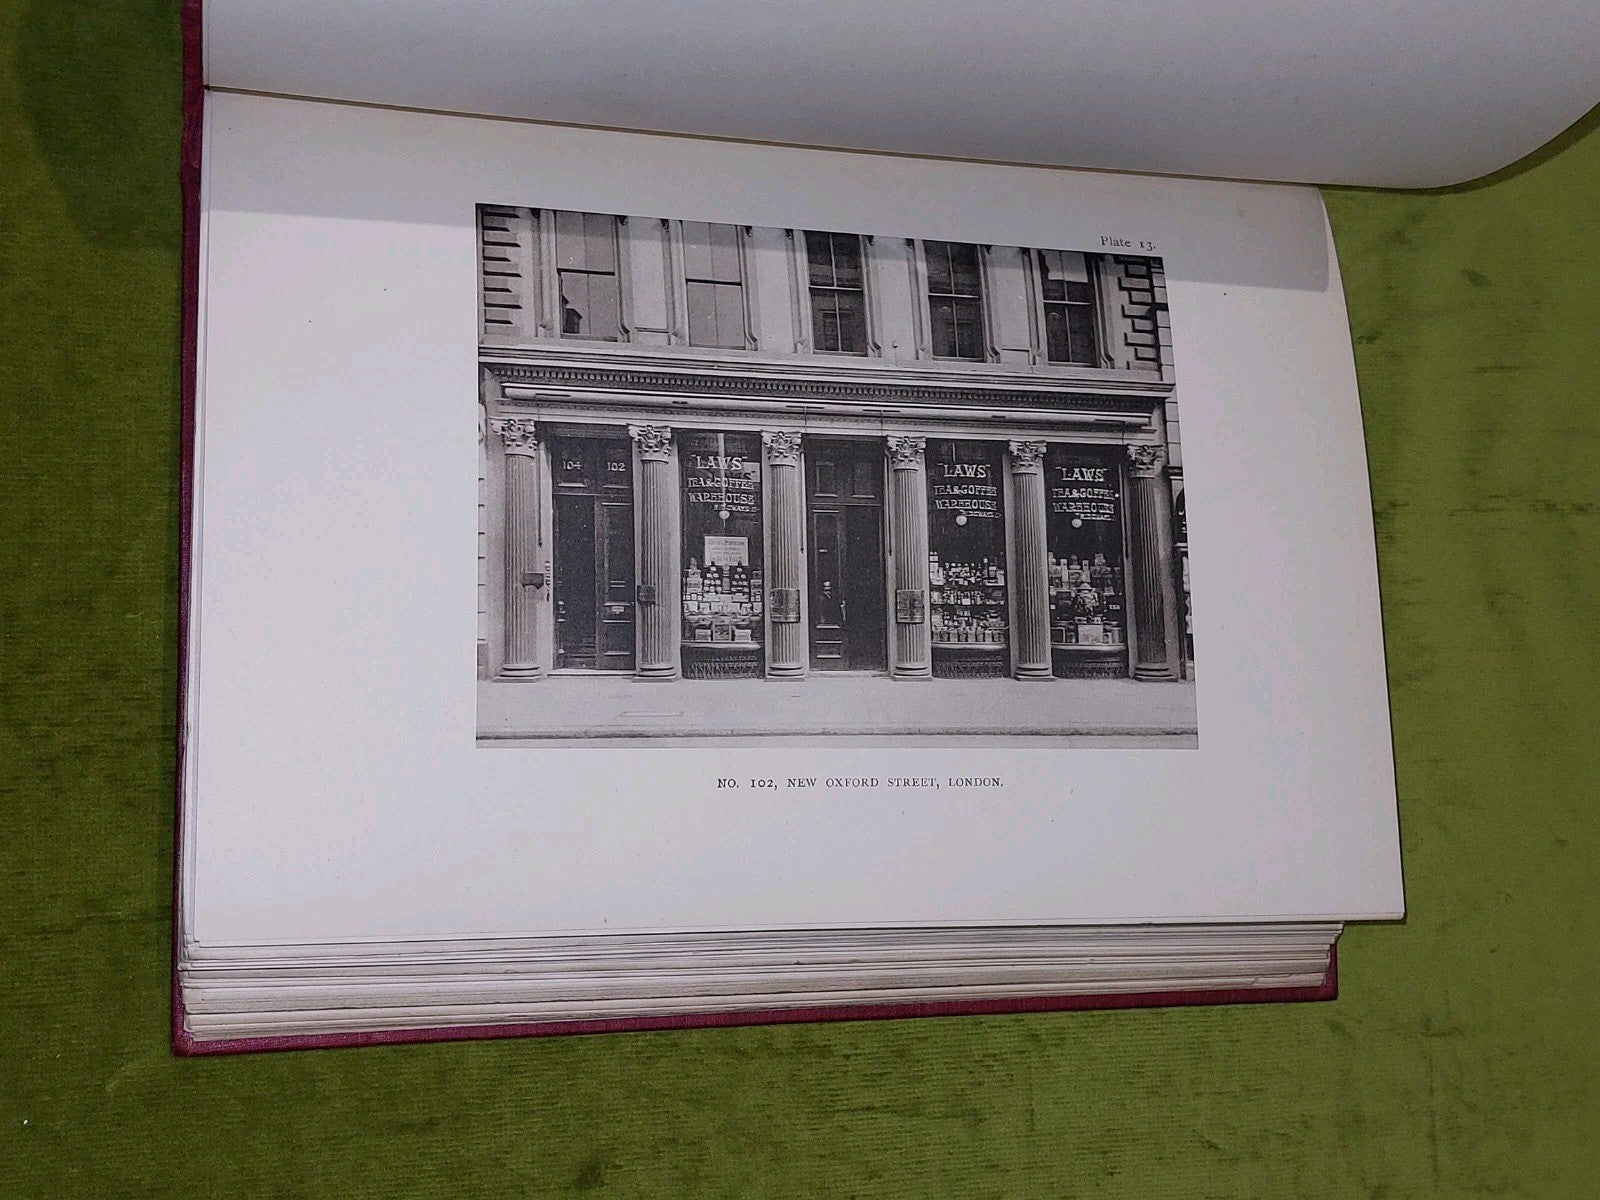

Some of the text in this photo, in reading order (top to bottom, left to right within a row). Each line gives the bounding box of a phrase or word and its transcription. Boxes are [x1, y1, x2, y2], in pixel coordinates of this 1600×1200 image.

[1100, 235, 1156, 252] Plate 13.
[562, 460, 582, 470] 104
[606, 461, 626, 472] 102
[717, 777, 1004, 791] NO. 102, NEW OXFORD STREET, LONDON.
